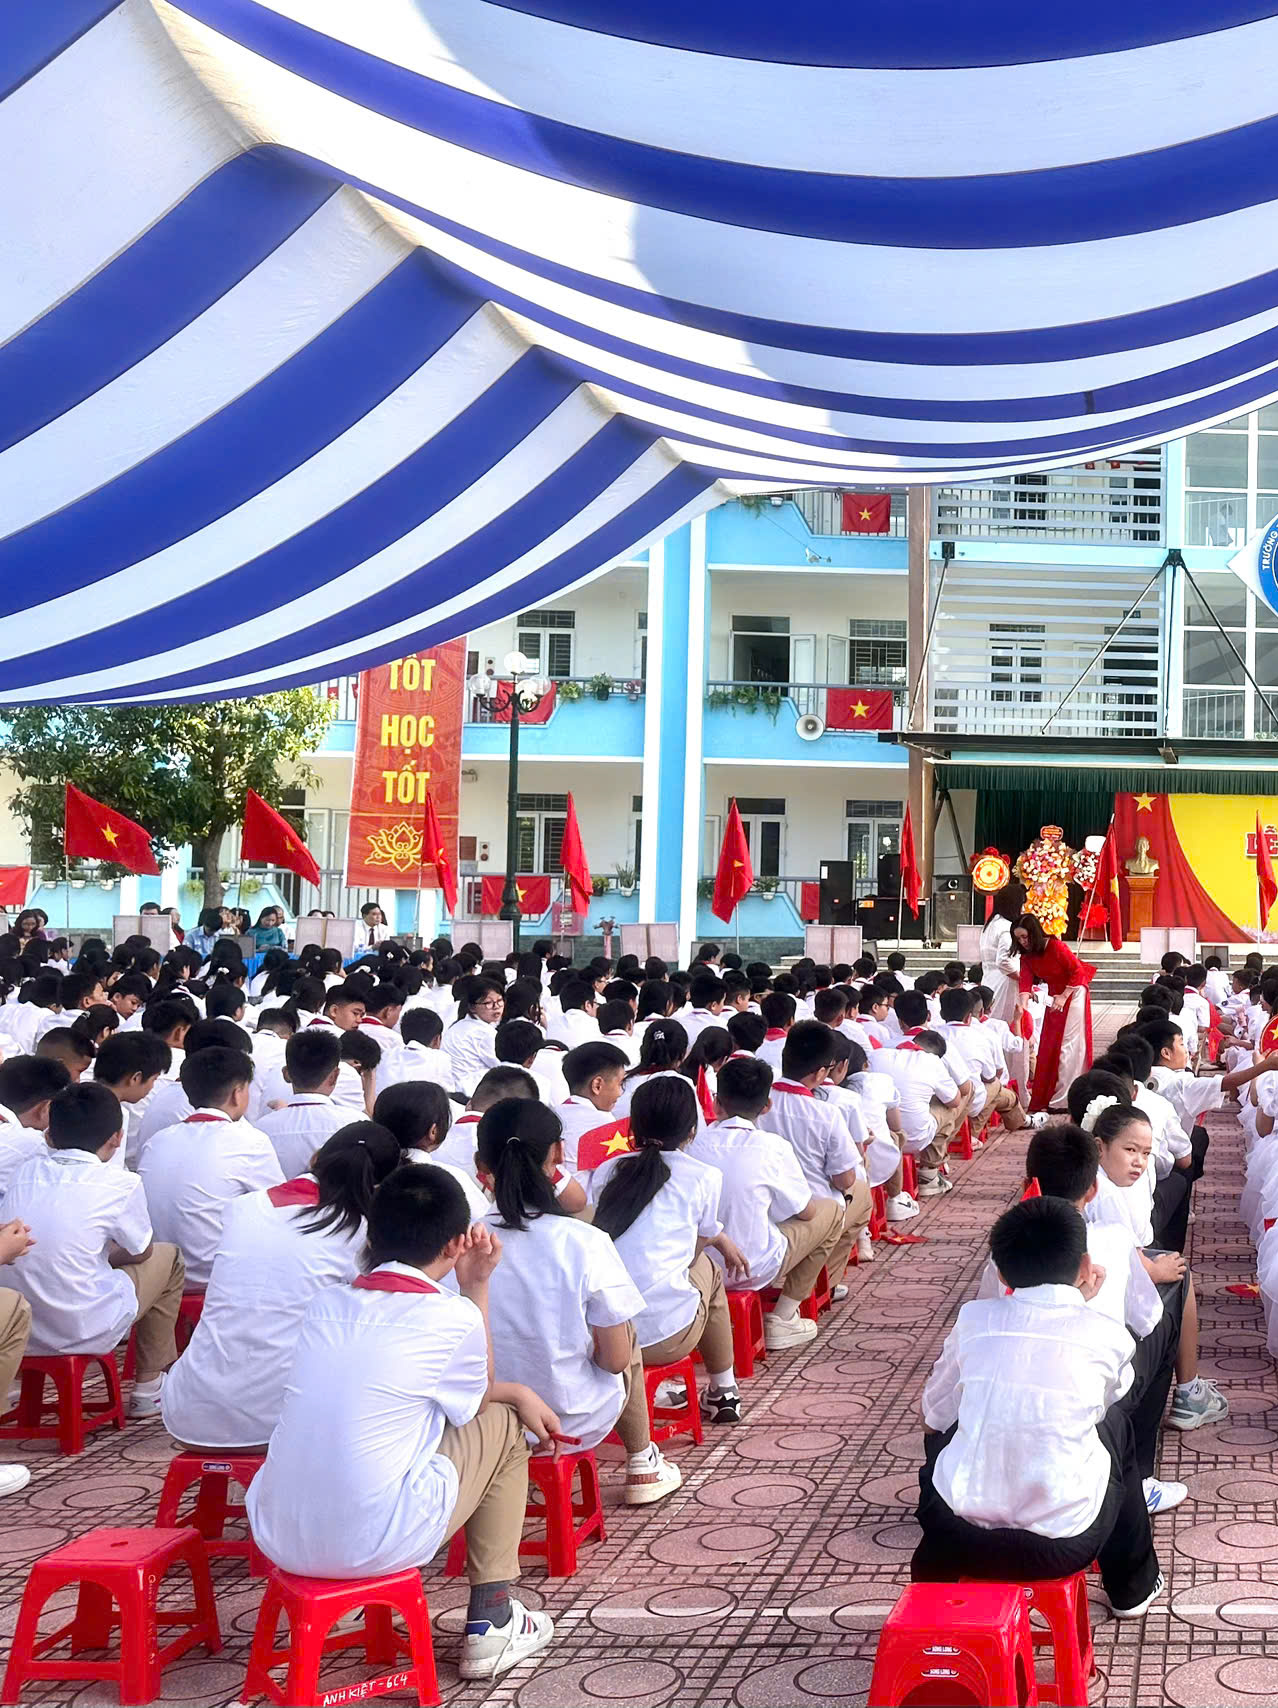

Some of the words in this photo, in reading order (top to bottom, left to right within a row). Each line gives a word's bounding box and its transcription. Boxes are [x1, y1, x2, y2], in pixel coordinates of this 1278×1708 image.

[1262, 531, 1278, 570] TRƯỜNG
[380, 714, 435, 754] HỌC
[382, 759, 431, 804] TỐT
[323, 1691, 346, 1707] ANH
